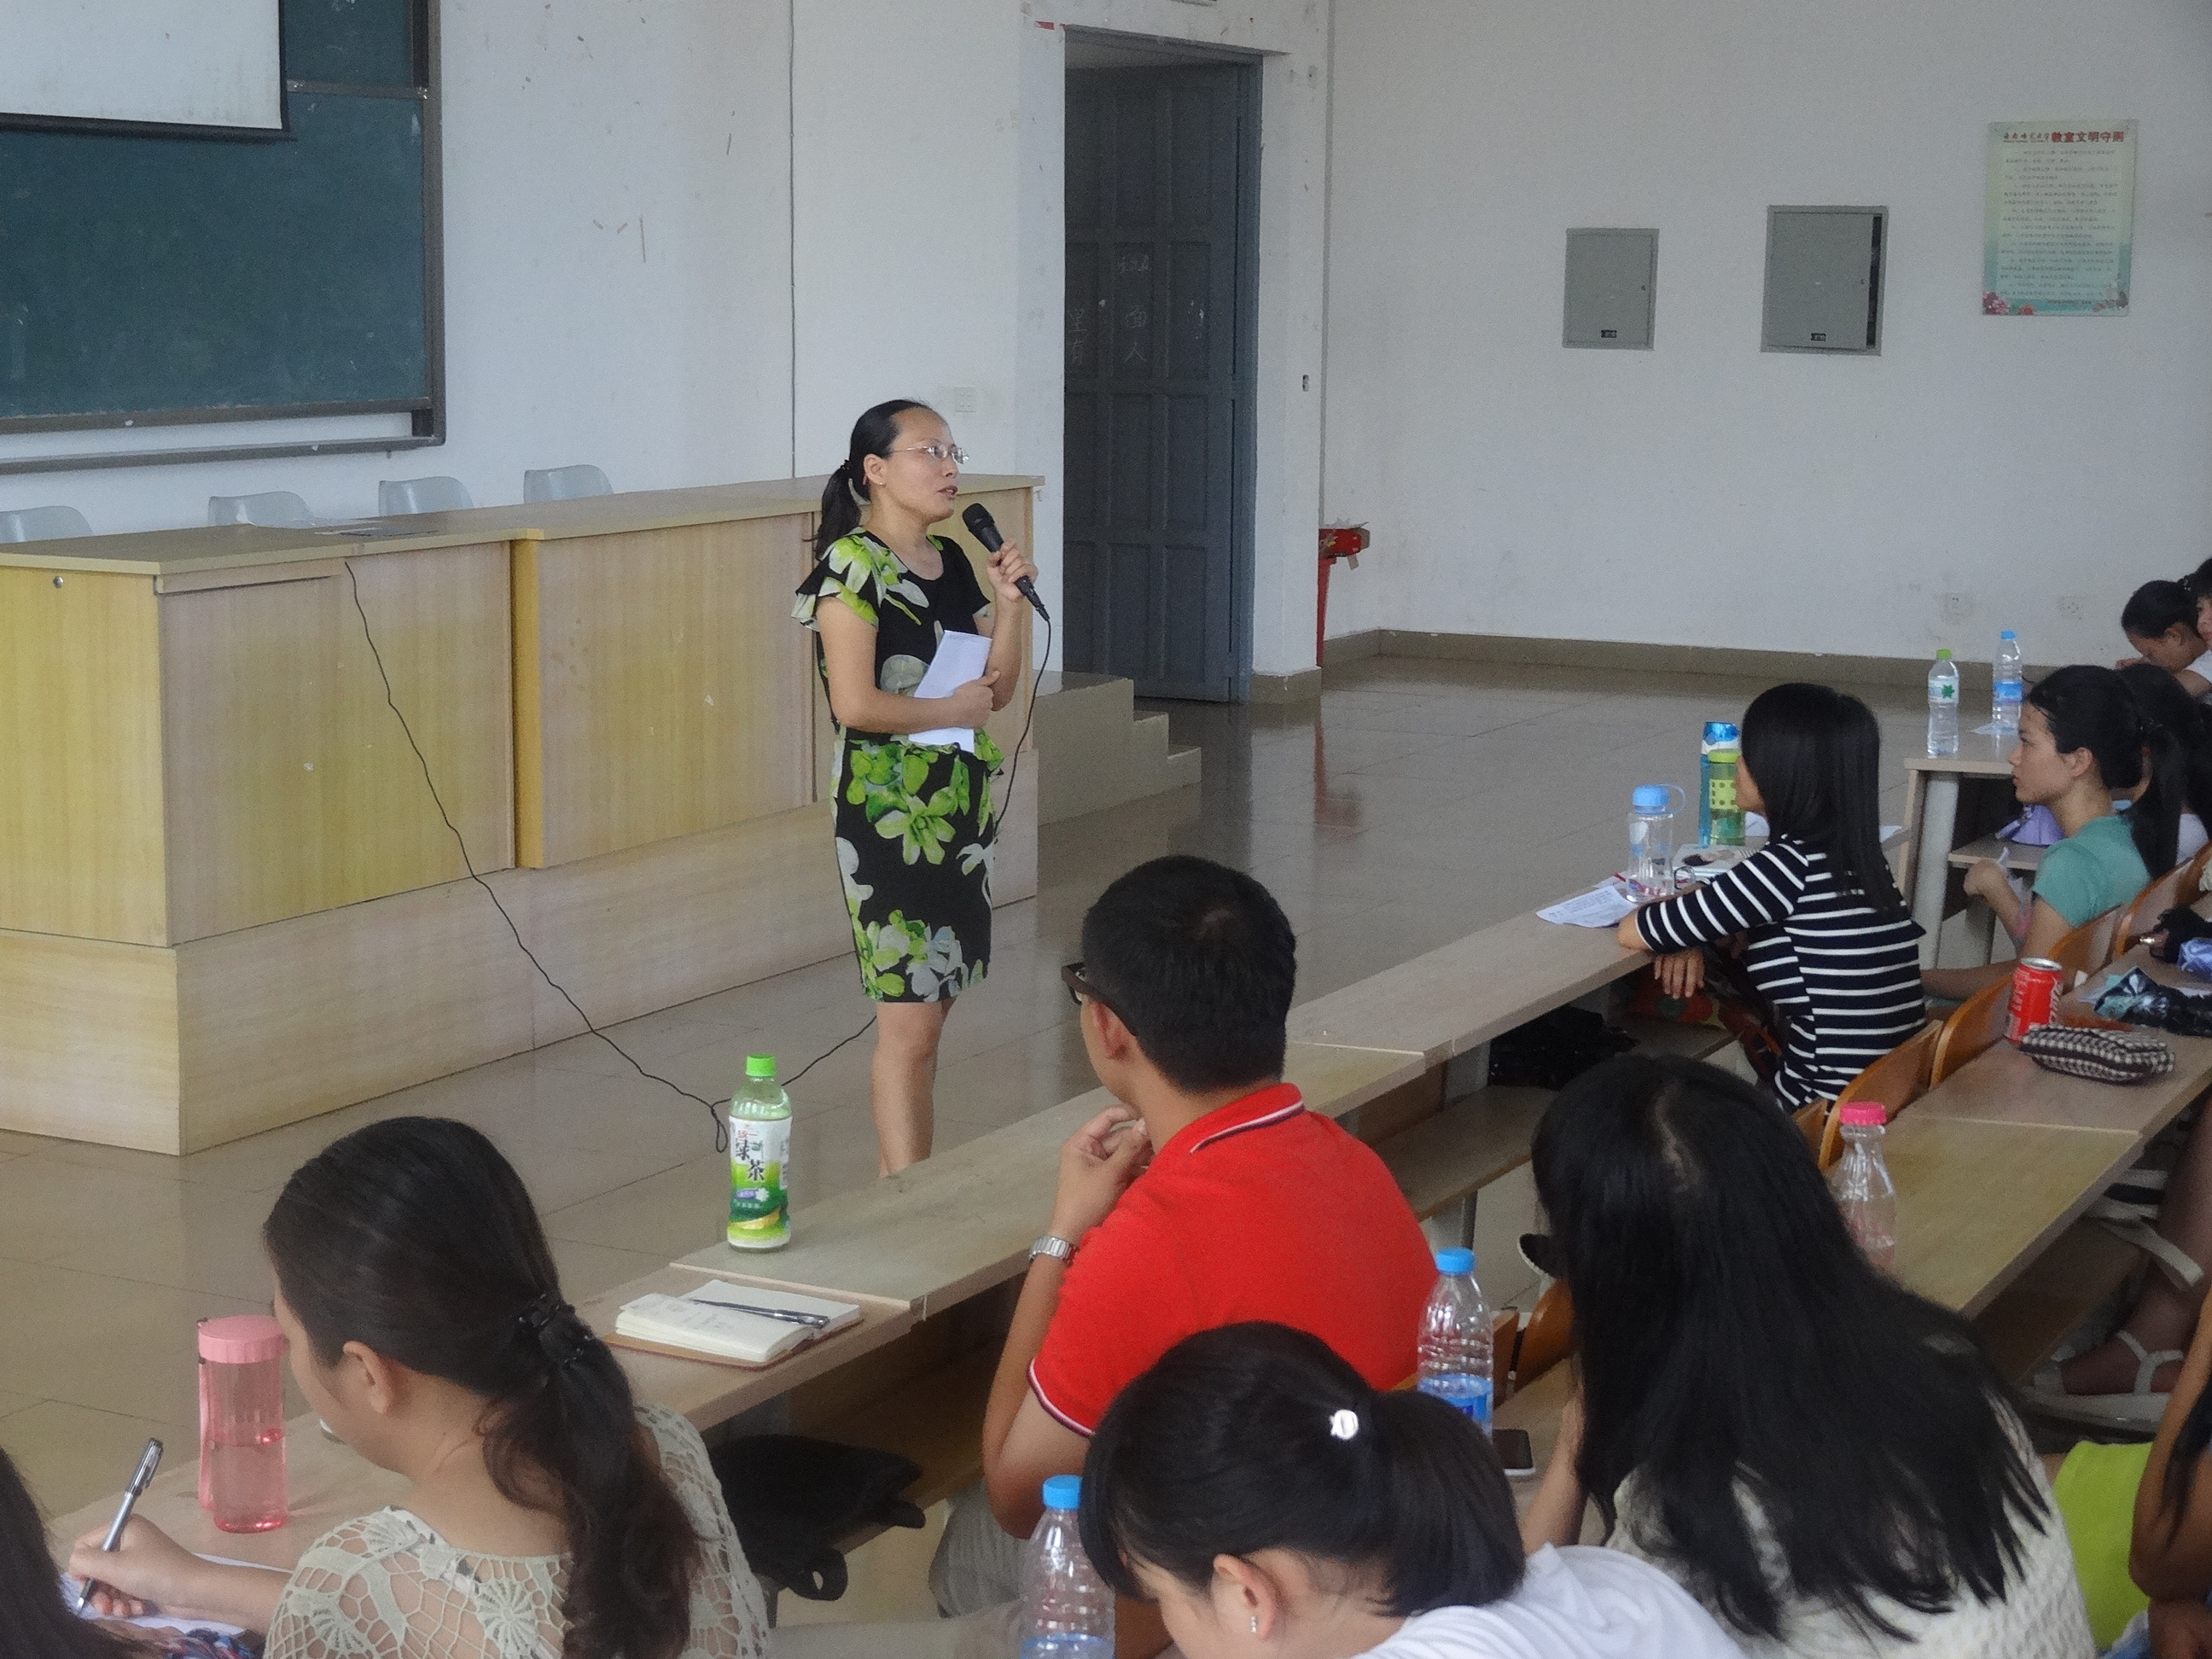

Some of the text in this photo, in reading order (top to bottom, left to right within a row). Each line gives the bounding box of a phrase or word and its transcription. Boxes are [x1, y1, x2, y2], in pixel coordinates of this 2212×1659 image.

[2052, 131, 2124, 143] 教室文明守则
